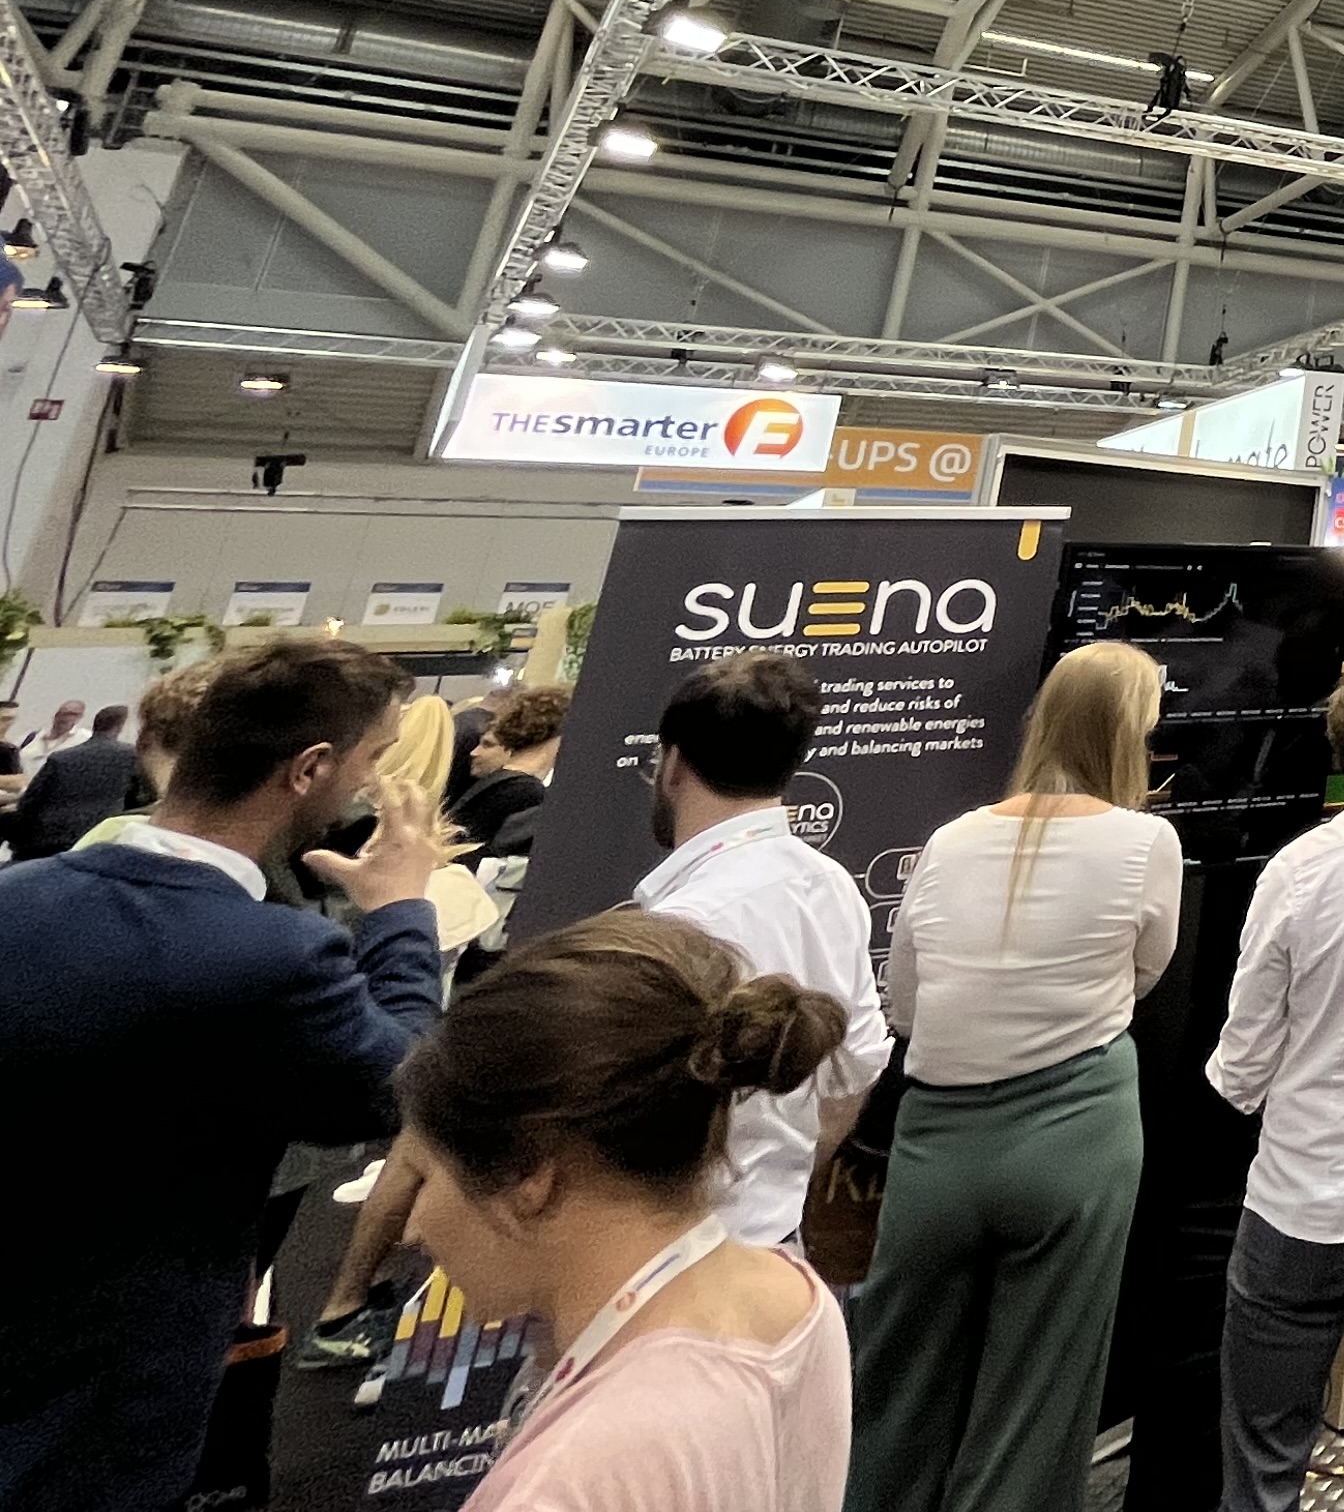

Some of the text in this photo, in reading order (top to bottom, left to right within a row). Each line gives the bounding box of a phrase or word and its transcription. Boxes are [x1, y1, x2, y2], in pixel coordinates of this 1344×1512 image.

[645, 444, 710, 459] EUROPE
[821, 641, 898, 657] TRADING
[898, 638, 988, 655] AUTOPILOT
[820, 677, 955, 696] trading services to
[820, 693, 963, 715] and reduce risks of
[846, 717, 922, 734] renewable
[925, 714, 985, 734] energies
[819, 742, 849, 757] and
[851, 739, 922, 757] balancing
[925, 737, 984, 752] markets
